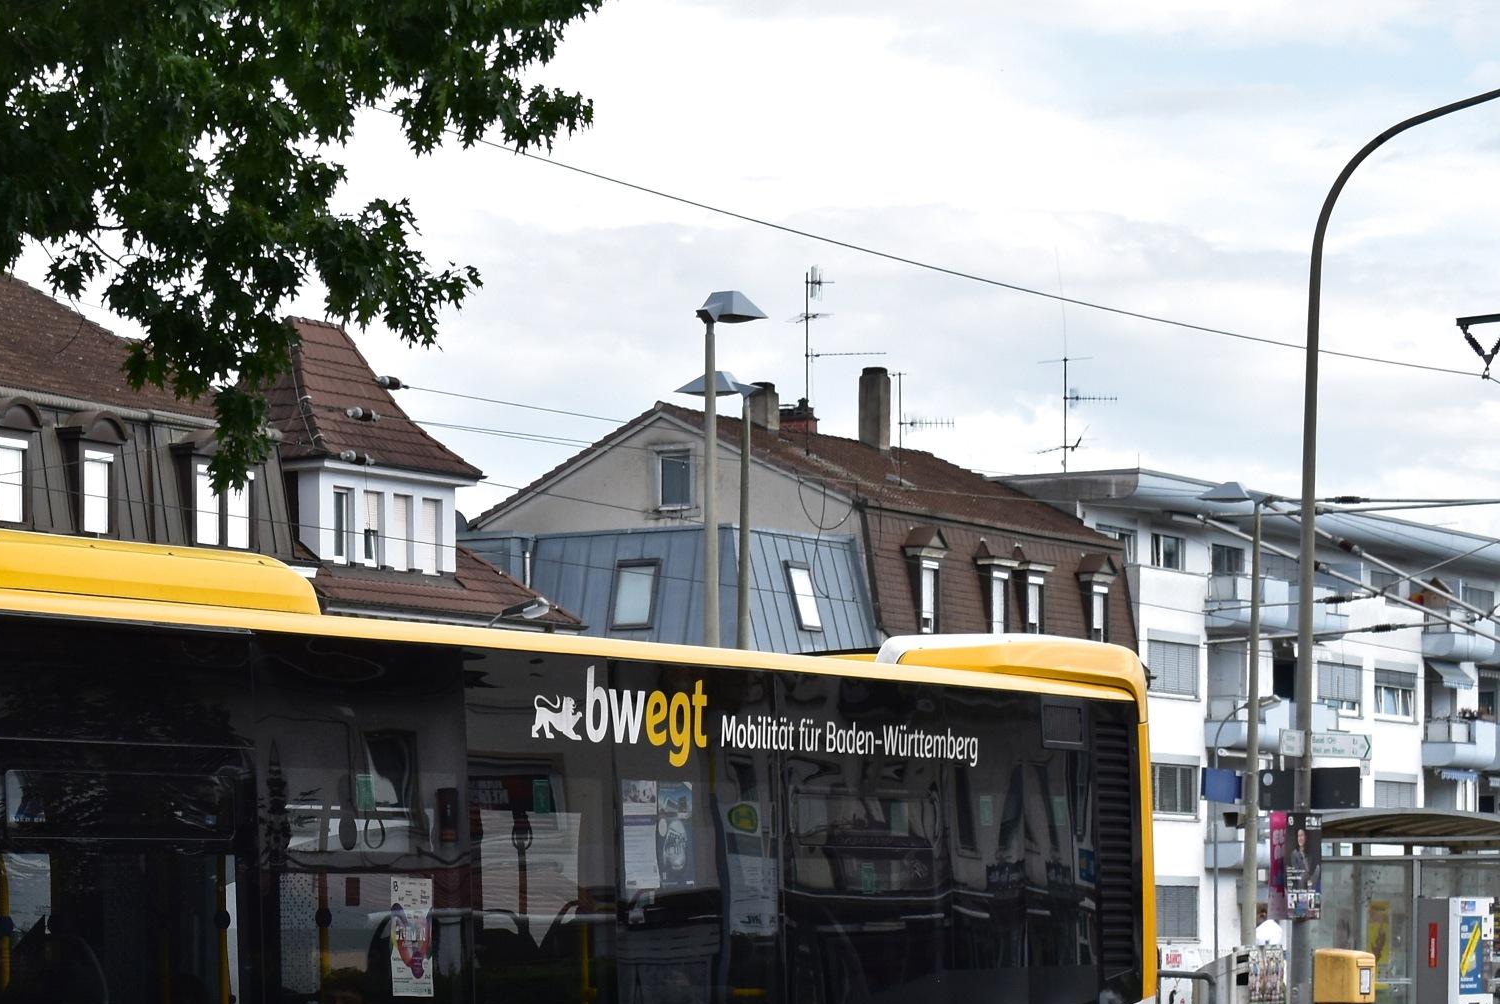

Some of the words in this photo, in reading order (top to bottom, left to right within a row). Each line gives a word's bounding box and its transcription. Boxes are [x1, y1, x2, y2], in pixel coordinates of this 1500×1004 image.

[585, 665, 708, 768] bwegt
[720, 714, 795, 751] Mobilität
[799, 718, 822, 752] für
[825, 721, 979, 767] Baden-Württemberg
